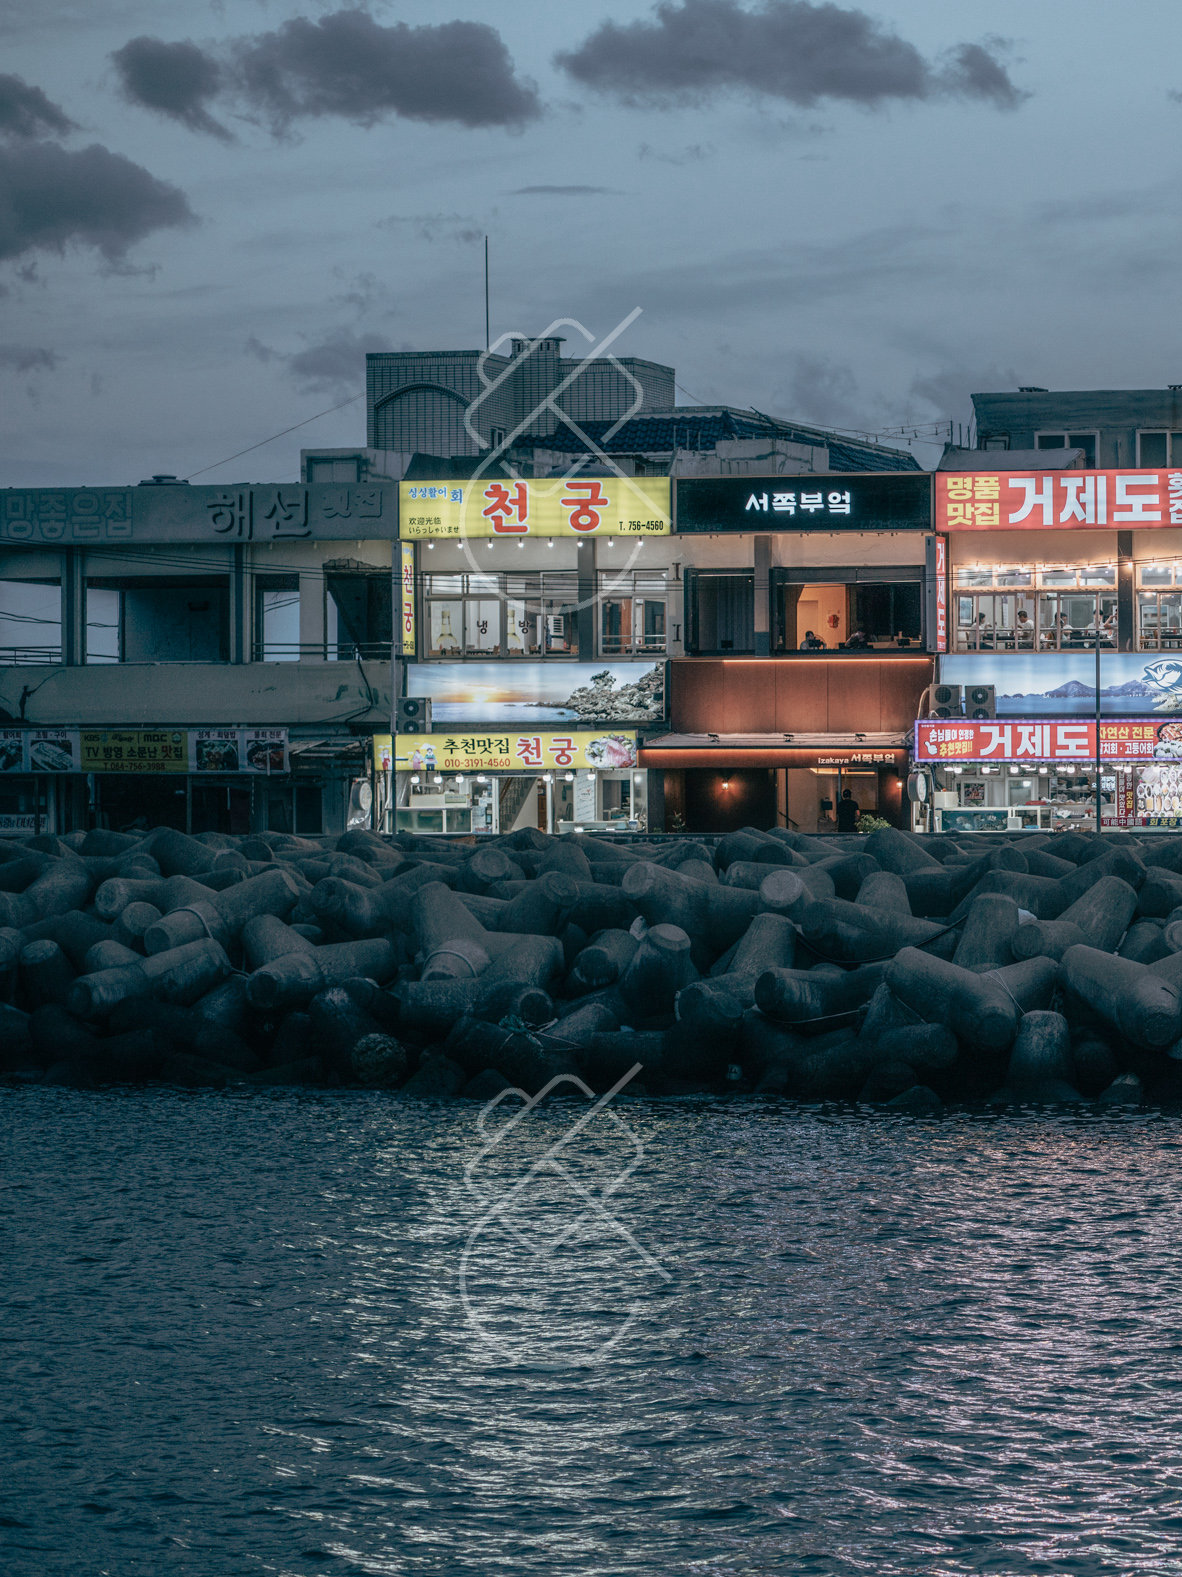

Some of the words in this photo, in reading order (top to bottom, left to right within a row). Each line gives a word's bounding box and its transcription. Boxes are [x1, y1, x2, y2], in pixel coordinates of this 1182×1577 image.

[408, 486, 447, 499] 싱싱활어
[450, 488, 463, 504] 회
[947, 477, 1000, 500] 명품
[481, 481, 610, 535] 천궁
[745, 491, 851, 515] 서쪽부엌
[1009, 474, 1161, 525] 거제도
[408, 517, 442, 525] 欢迎光临
[947, 503, 1000, 526] 맛집
[408, 526, 459, 534] いらっしゃいませ
[619, 521, 626, 530] T.
[628, 520, 663, 531] 756-4560
[937, 543, 946, 637] 거제도
[403, 565, 414, 633] 천궁
[476, 621, 488, 634] 냉
[518, 621, 530, 634] 방
[929, 729, 957, 743] 손님들이
[958, 729, 975, 740] 인정한
[980, 725, 1090, 757] 거제도
[1100, 727, 1129, 739] 자연산
[1132, 727, 1153, 739] 전문
[86, 747, 99, 758] TV
[103, 747, 123, 759] 방영
[127, 746, 158, 758] 소문난
[161, 745, 183, 759] 맛집
[442, 738, 510, 754] 추천맛집
[516, 736, 578, 767] 천궁
[1125, 743, 1154, 755] 고등어회
[444, 758, 511, 768] 010-3191-4560
[1126, 791, 1133, 808] 맛집
